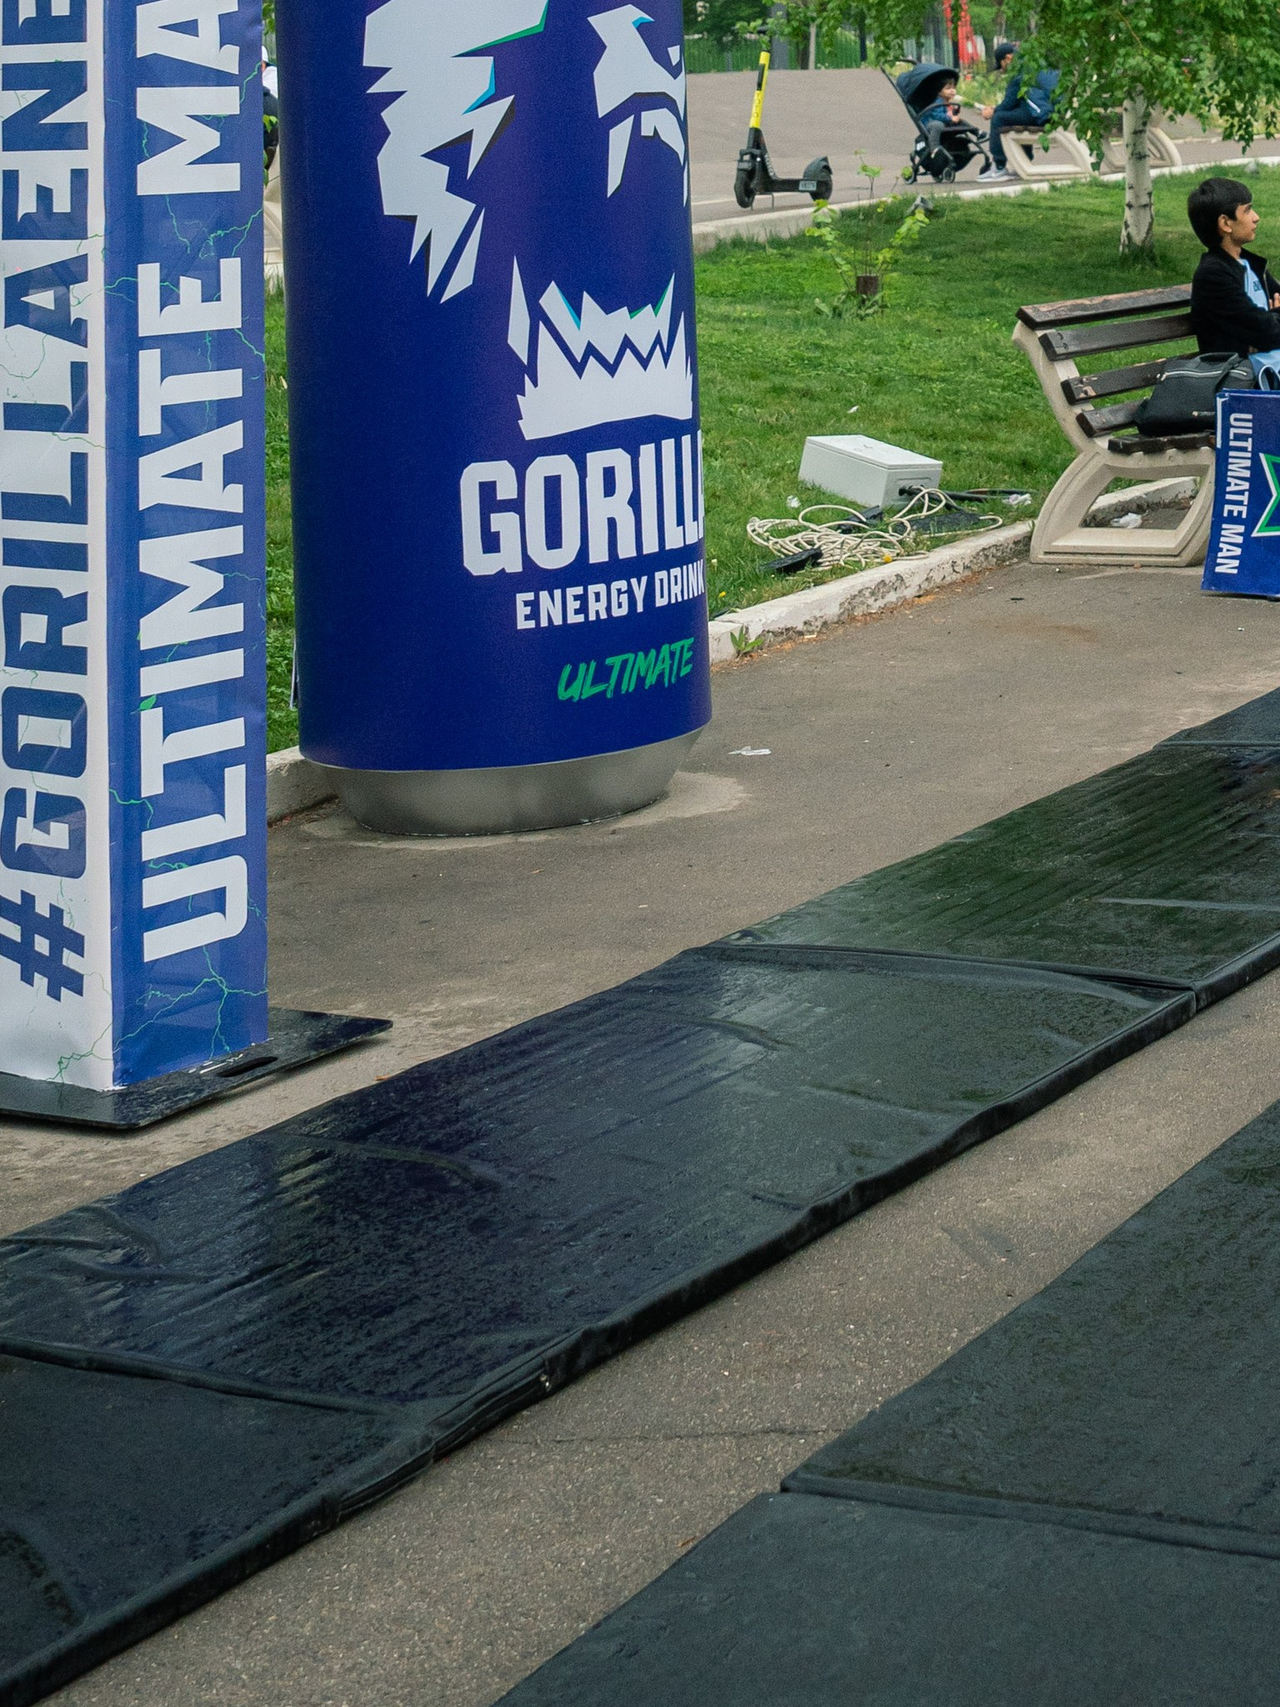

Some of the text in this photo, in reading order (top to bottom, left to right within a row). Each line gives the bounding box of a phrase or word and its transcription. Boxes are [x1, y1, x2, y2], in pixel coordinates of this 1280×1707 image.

[1214, 412, 1254, 575] ULTIMATE MAN
[137, 257, 248, 963] ULTIMATE
[516, 559, 705, 630] ENERGY DRINK
[557, 637, 695, 702] ULTIMATE
